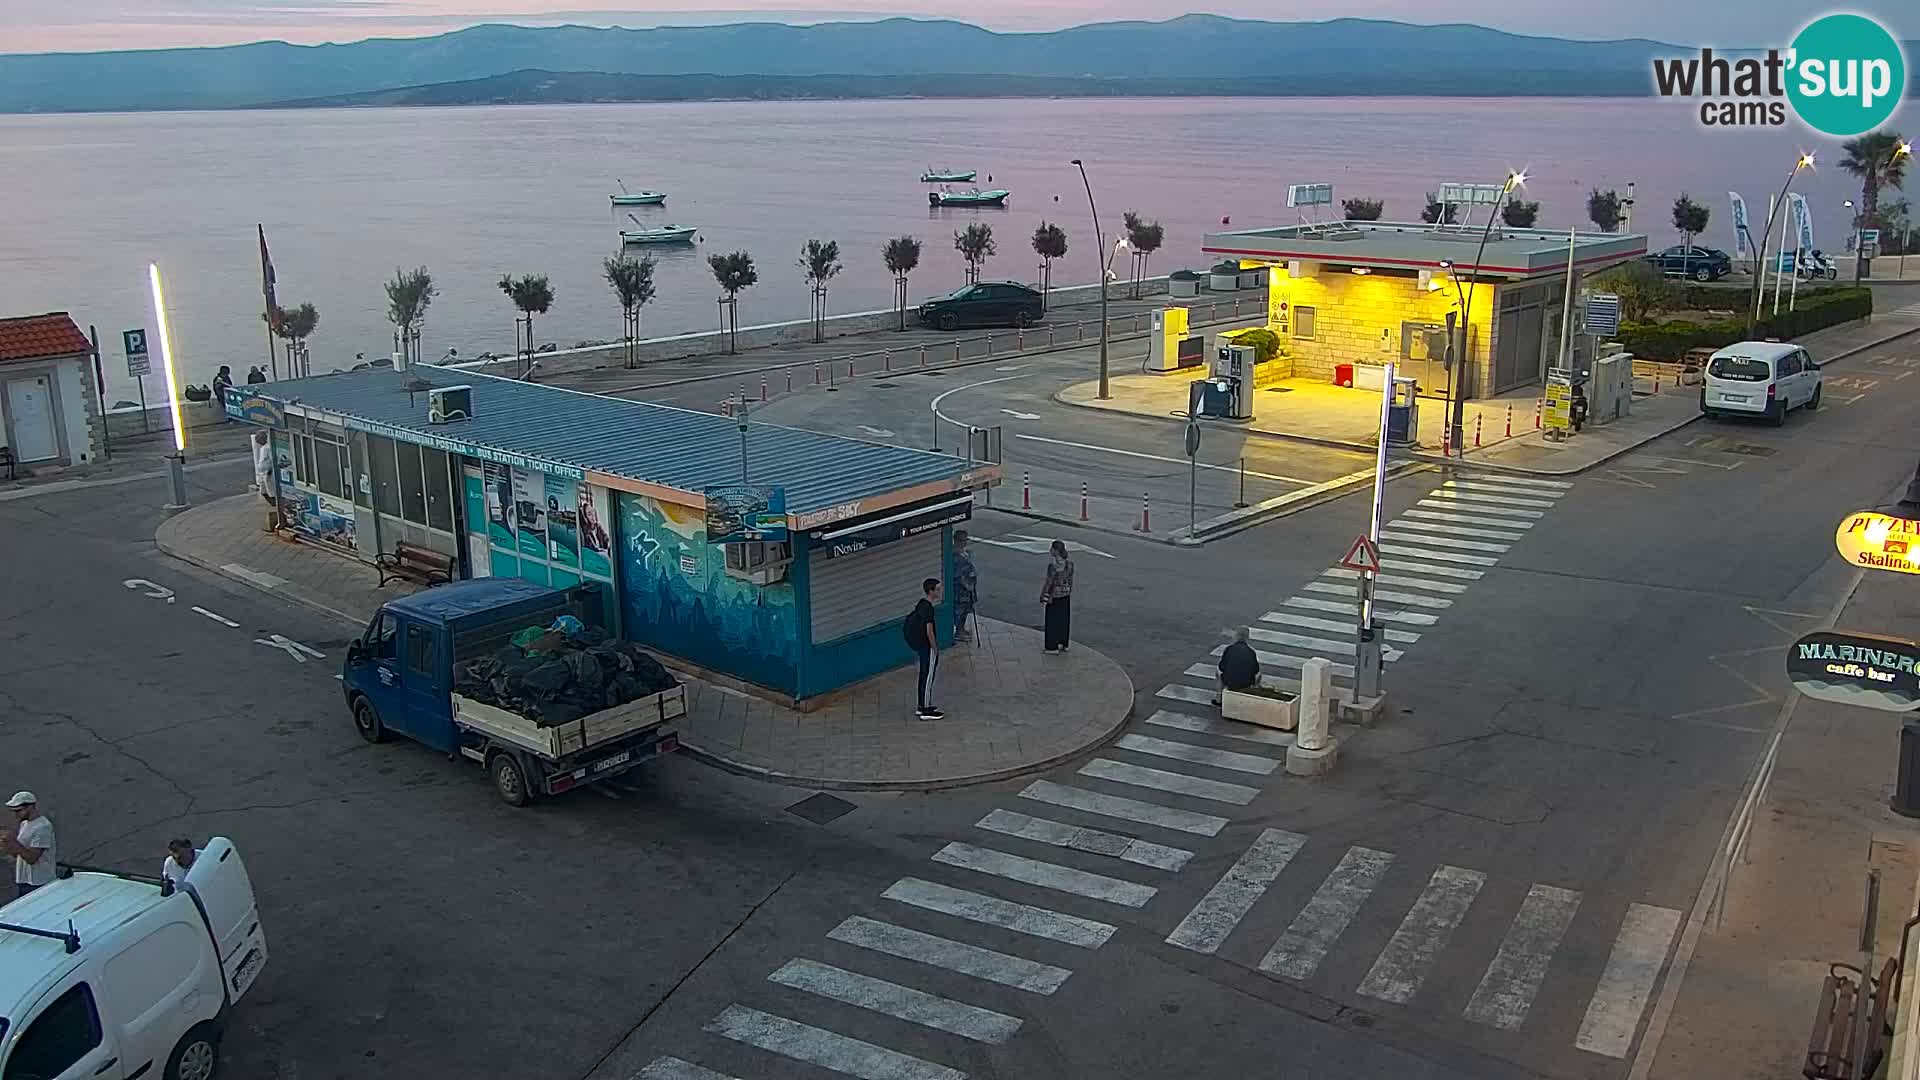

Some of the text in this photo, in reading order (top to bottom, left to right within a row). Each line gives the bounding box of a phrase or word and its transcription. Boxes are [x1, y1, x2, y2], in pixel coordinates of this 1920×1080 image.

[128, 333, 142, 352] P
[435, 438, 466, 454] POSTAJA
[477, 447, 492, 460] BUS
[493, 451, 525, 467] STATION
[528, 458, 553, 473] TICKET
[554, 465, 581, 479] OFFICE
[833, 540, 867, 557] iNovine
[1826, 663, 1896, 683] caffe bar
